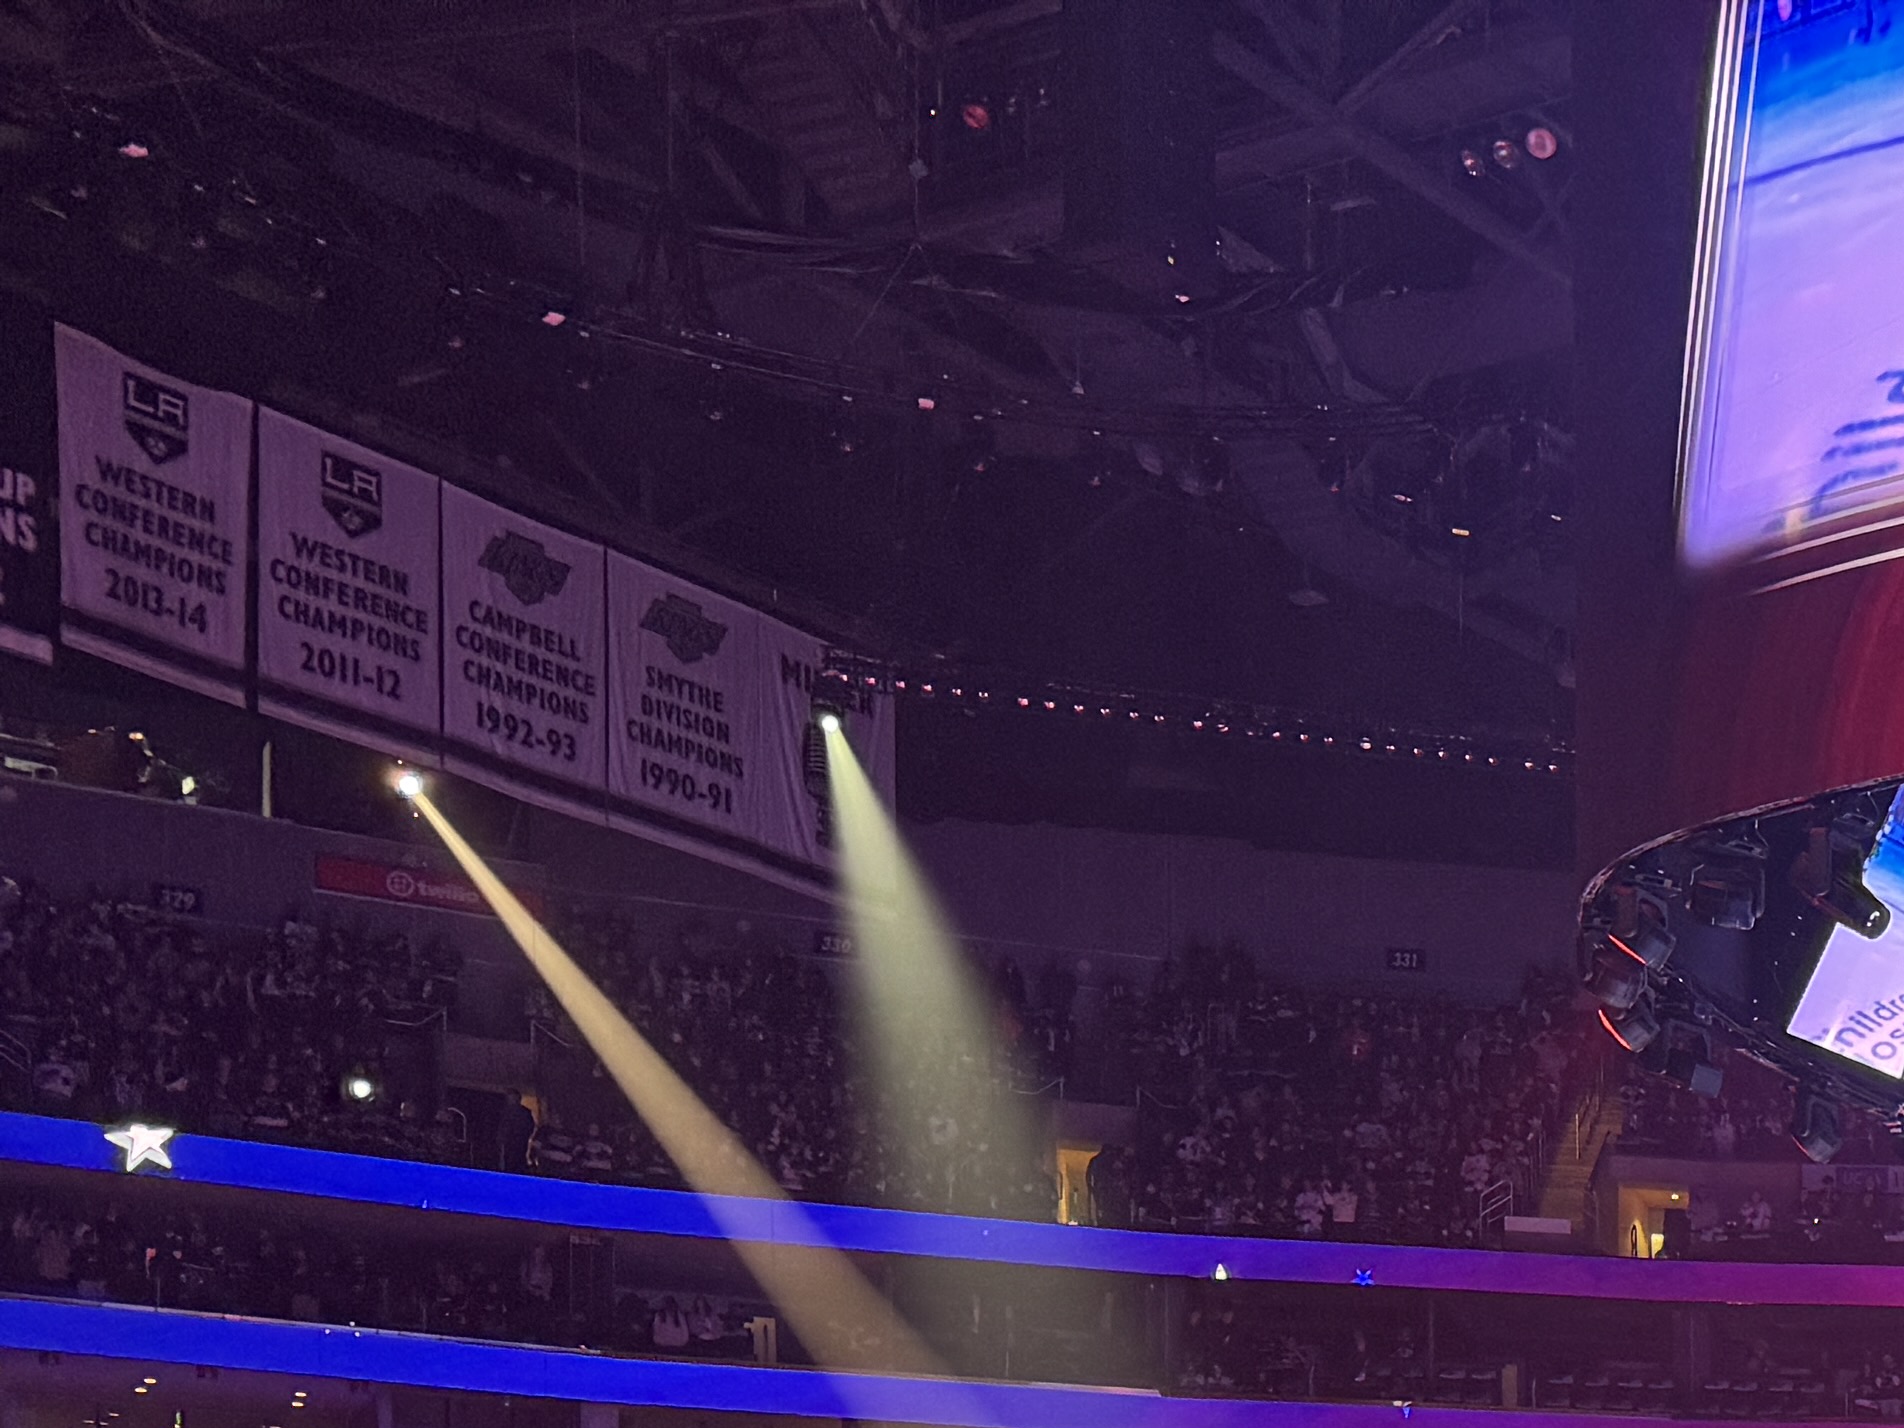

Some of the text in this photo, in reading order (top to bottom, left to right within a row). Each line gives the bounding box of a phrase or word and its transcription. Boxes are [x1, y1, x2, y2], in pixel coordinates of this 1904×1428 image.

[127, 379, 186, 425] LA
[95, 455, 215, 526] WESTERN
[323, 456, 380, 502] LA
[75, 482, 233, 566] CONFERENCE
[85, 521, 226, 595] CHAMPIONS
[289, 531, 408, 596] WESTERN
[105, 567, 207, 634] 2013-14
[270, 557, 429, 636] CONFERENCE
[277, 594, 421, 664] CHAMPIONS
[455, 625, 596, 697] CONFERENCE
[468, 599, 581, 662] CAMPBELL
[299, 641, 402, 701] 2011-12
[462, 659, 590, 725] CHAMPIONS
[645, 665, 724, 714] SMYTHE
[476, 701, 577, 762] 1992-93
[626, 718, 745, 779] CHAMPIONS
[641, 694, 731, 745] DIVISION
[640, 758, 734, 815] 1990-91
